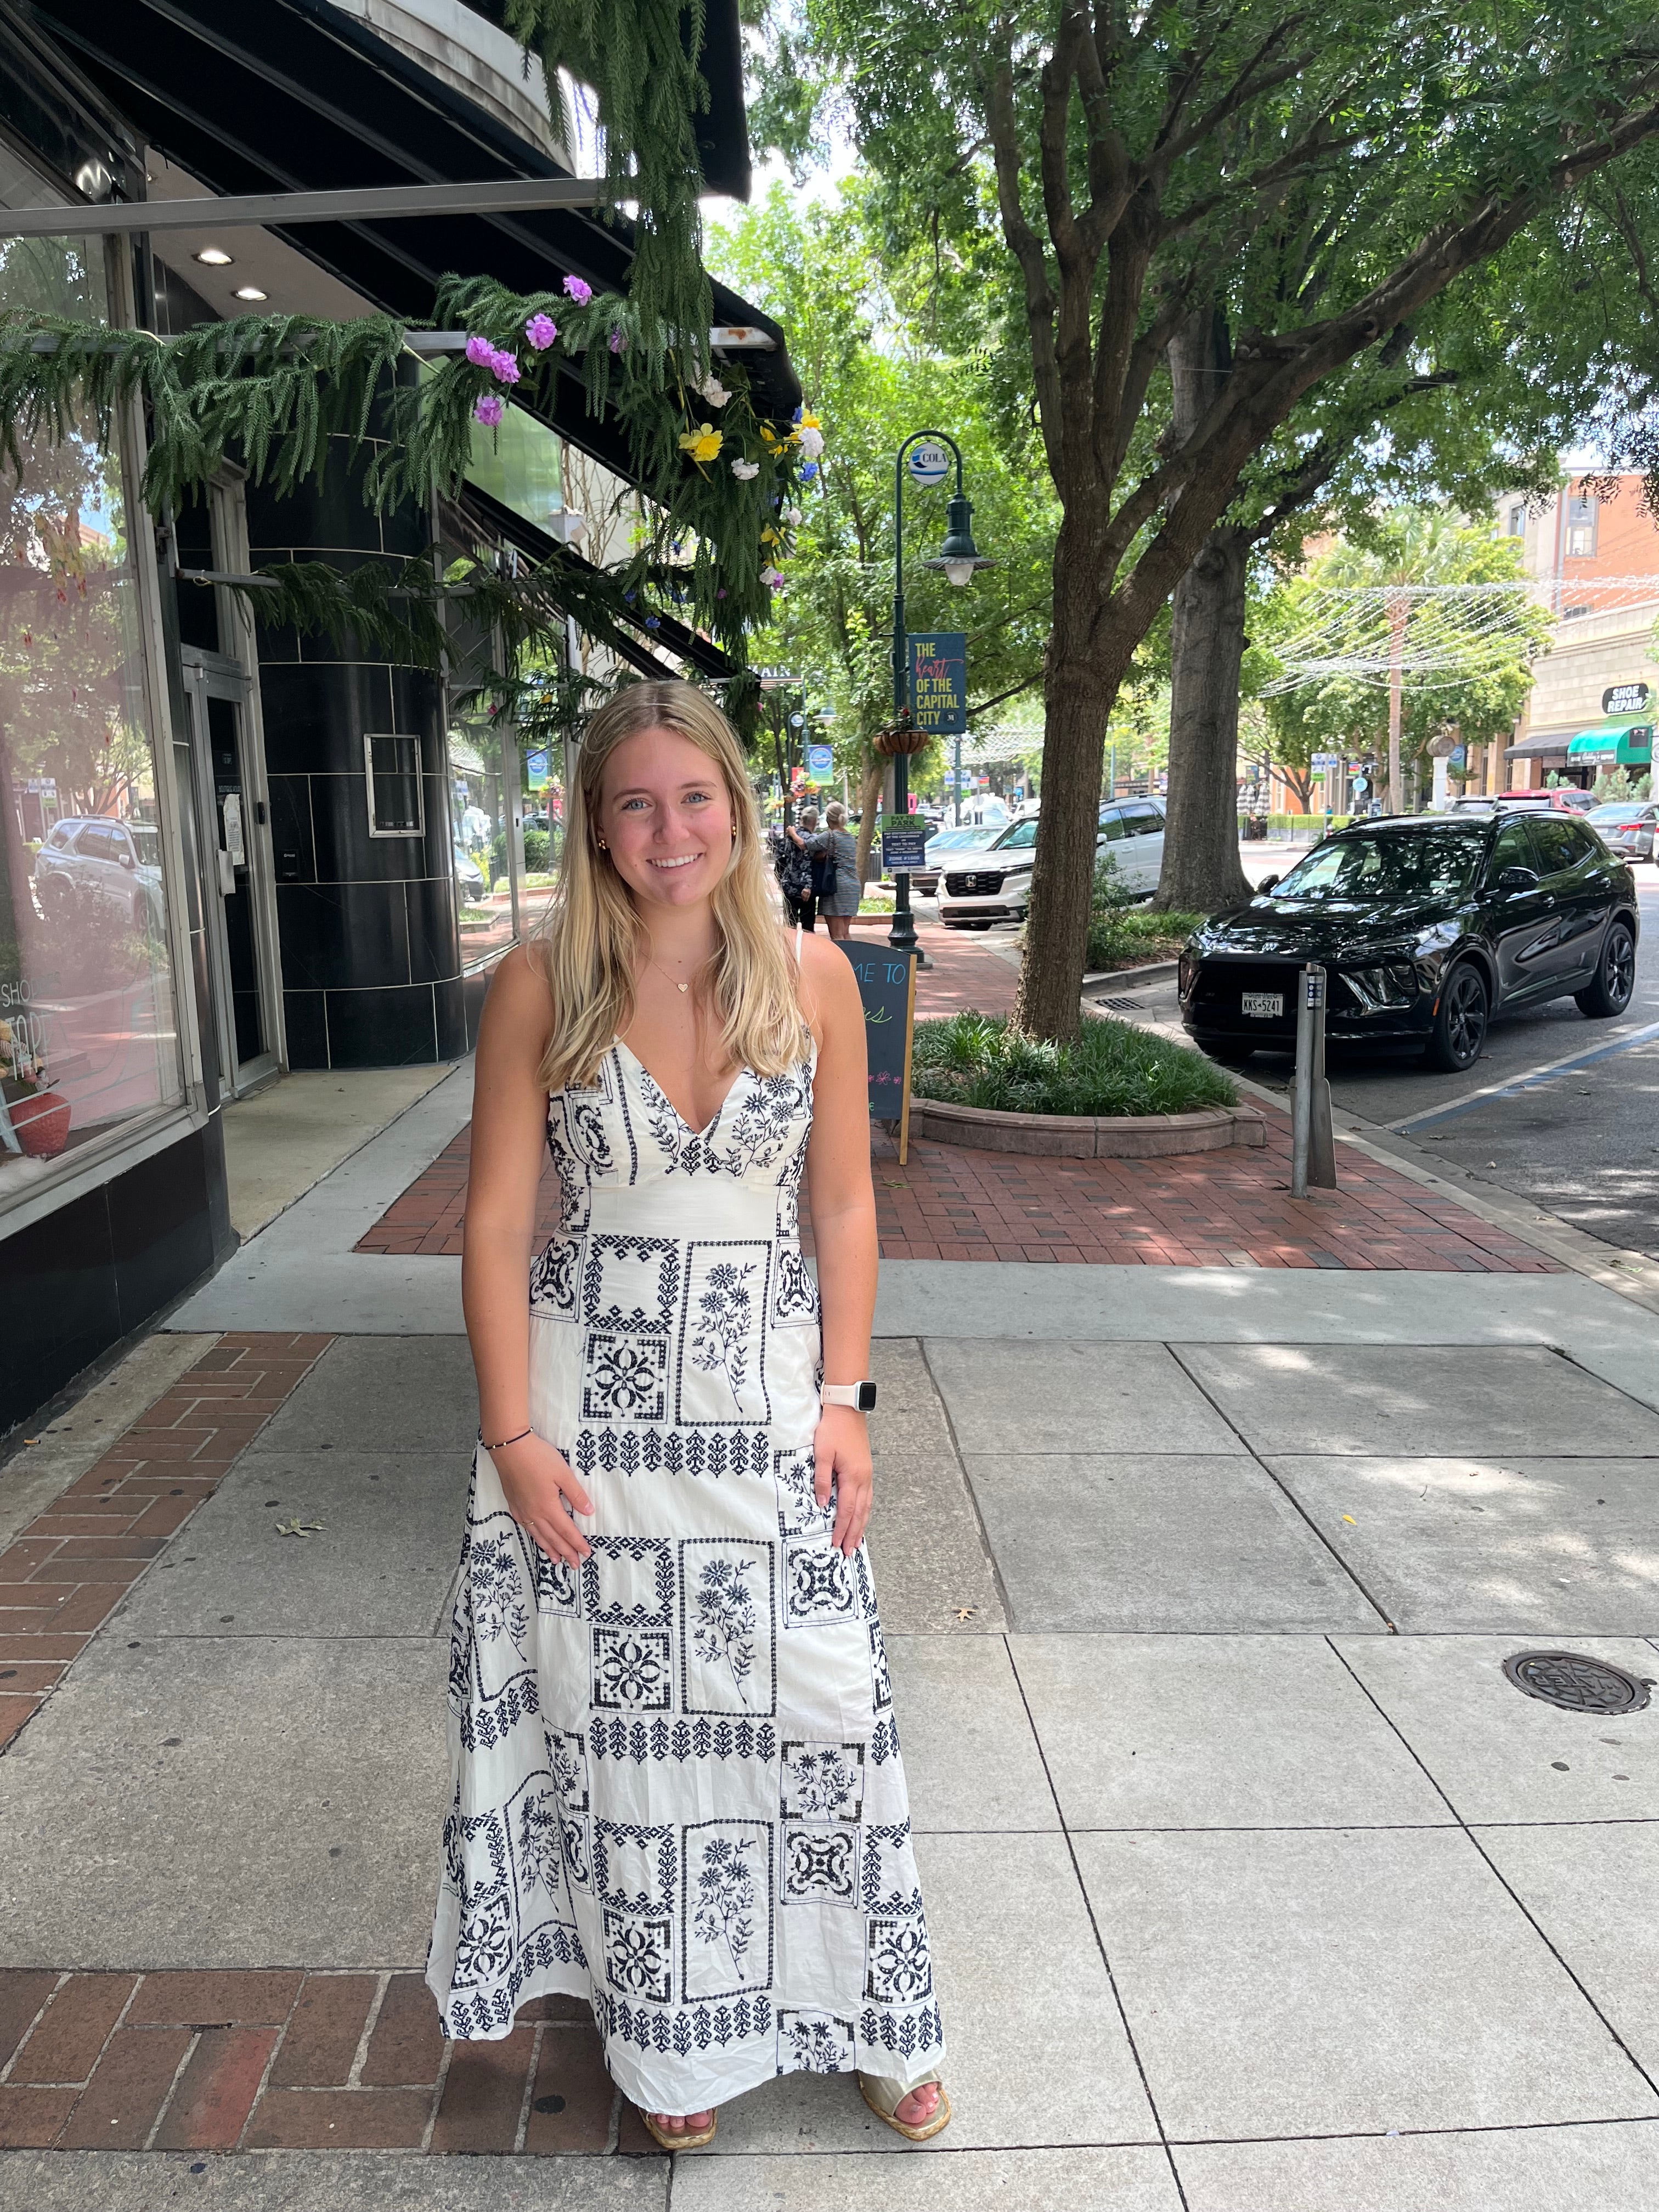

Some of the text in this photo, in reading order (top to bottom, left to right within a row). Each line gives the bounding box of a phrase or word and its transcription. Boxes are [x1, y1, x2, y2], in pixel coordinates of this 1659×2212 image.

[923, 453, 946, 462] COLA
[915, 642, 936, 657] THE
[916, 654, 964, 681] heart
[916, 678, 952, 693] OF THE
[1612, 685, 1640, 701] SHOE
[916, 694, 960, 709] CAPITAL
[1607, 697, 1643, 713] REPAIR
[917, 711, 941, 725] CITY
[853, 963, 906, 985] ME TO
[1244, 999, 1279, 1012] KKS 5241
